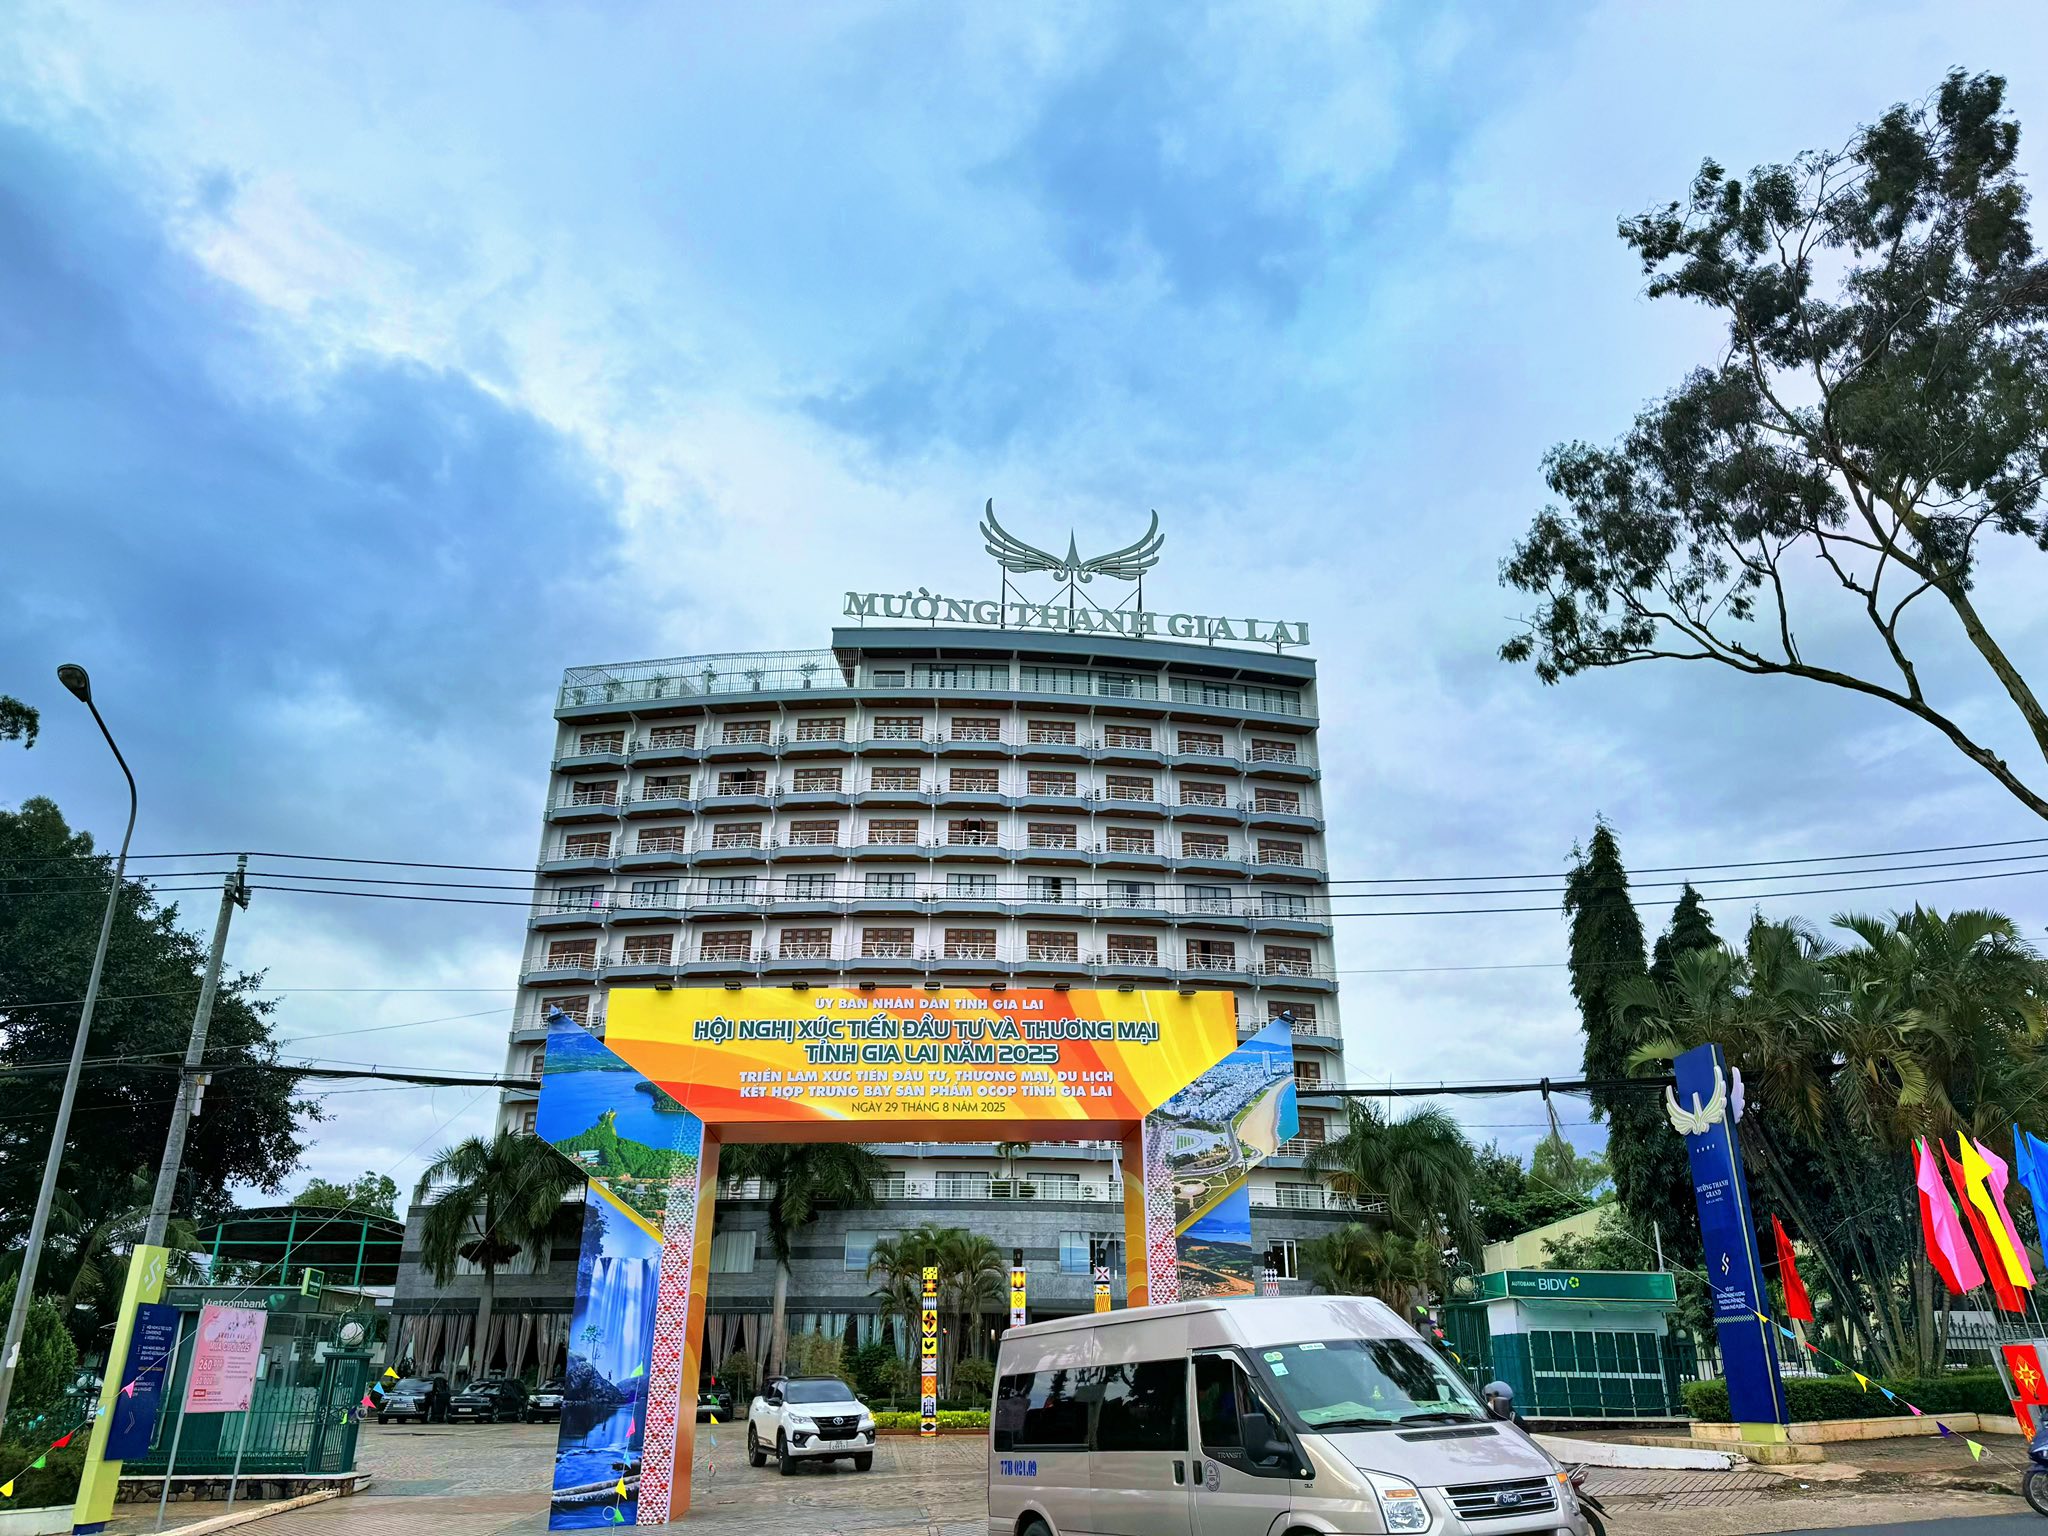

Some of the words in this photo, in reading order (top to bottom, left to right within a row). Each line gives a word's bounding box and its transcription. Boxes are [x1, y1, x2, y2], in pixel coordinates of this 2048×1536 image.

[843, 587, 1000, 624] MƯỜNG
[1010, 602, 1157, 635] THANH
[1167, 614, 1237, 640] GIA
[1244, 619, 1310, 645] LAI
[838, 998, 868, 1009] BAN
[873, 996, 914, 1009] NHÂN
[919, 997, 950, 1009] DÂN
[993, 999, 1018, 1010] GIA
[1022, 999, 1044, 1010] LAI
[693, 1017, 733, 1044] HỘI
[739, 1019, 794, 1044] NGHỊ
[797, 1016, 844, 1040] XÚC
[848, 1013, 899, 1040] TIẾN
[901, 1012, 951, 1040] ĐẦU
[954, 1018, 986, 1040] TƯ
[988, 1017, 1020, 1040] VÀ
[1022, 1017, 1112, 1040] THƯƠNG
[1117, 1021, 1160, 1045] MẠI
[804, 1039, 857, 1064] TỈNH
[861, 1044, 901, 1064] GIA
[904, 1044, 940, 1064] LAI
[943, 1041, 994, 1064] NĂM
[998, 1044, 1059, 1064] 2025
[822, 1068, 852, 1082] XÚC
[1058, 1071, 1078, 1082] DU
[1083, 1071, 1114, 1085] LỊCH
[771, 1086, 804, 1100] HỢP
[864, 1084, 892, 1097] BÀY
[977, 1086, 1017, 1097] OCOP
[1061, 1086, 1086, 1097] GIA
[1091, 1086, 1113, 1097] LAI
[852, 1100, 882, 1112] NGÀY
[885, 1102, 899, 1112] 29
[901, 1100, 940, 1112] THÁNG
[943, 1102, 949, 1112] 8
[981, 1102, 1006, 1113] 2025
[1538, 1278, 1568, 1291] BIDV
[203, 1298, 268, 1310] Vietcombank
[1000, 1460, 1013, 1475] 77B
[1503, 1493, 1517, 1504] Ford
